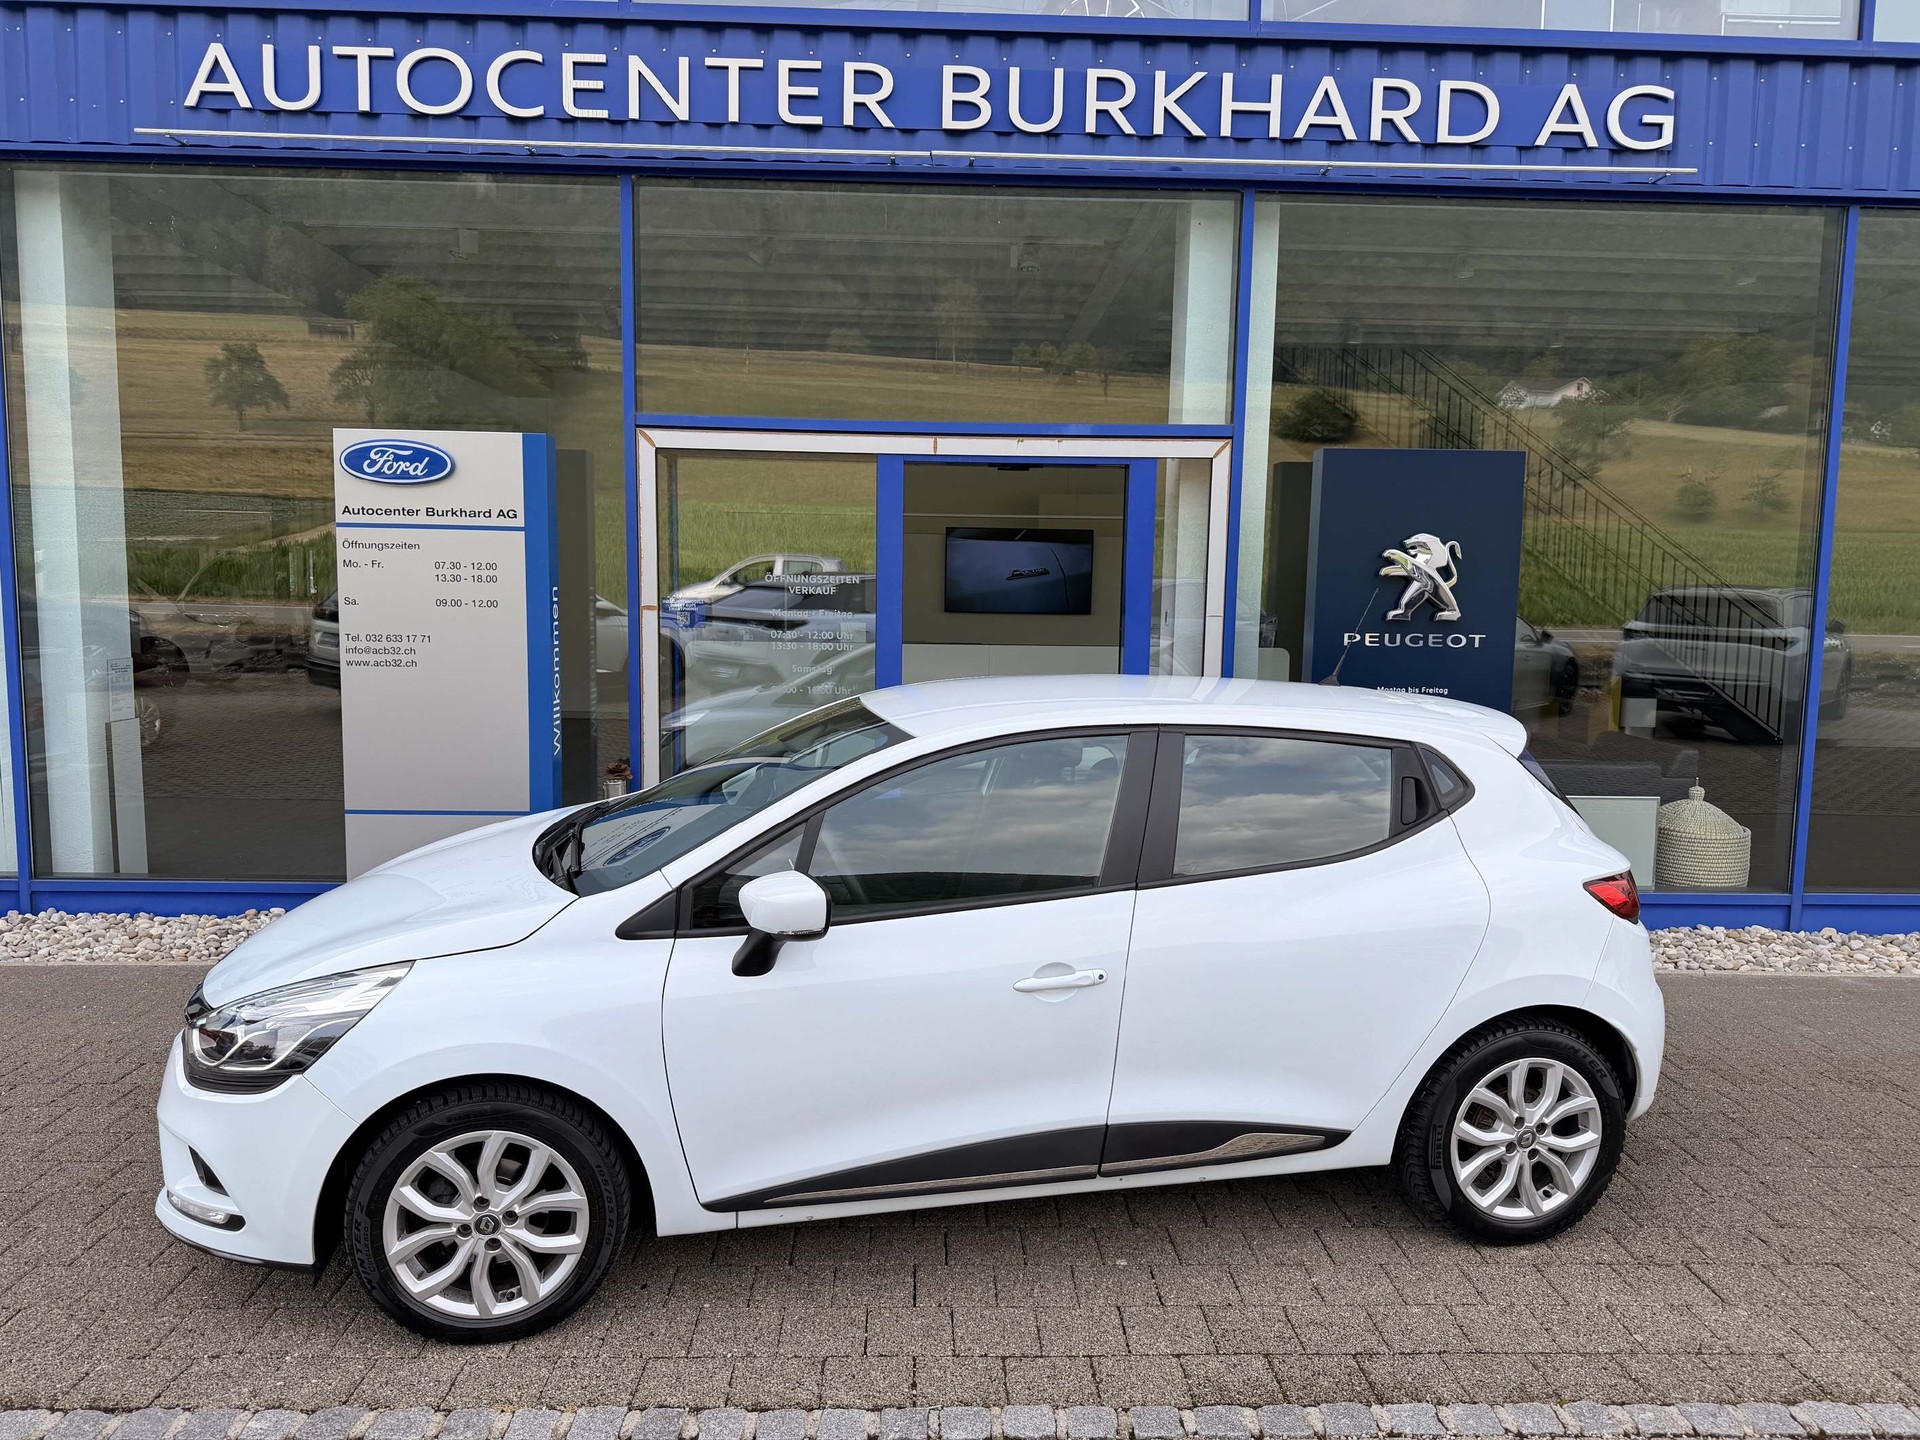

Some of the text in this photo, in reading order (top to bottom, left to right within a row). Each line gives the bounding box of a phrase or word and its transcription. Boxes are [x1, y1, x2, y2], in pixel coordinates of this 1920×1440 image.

[184, 41, 1676, 152] AUTOCENTER BURKHARD AG
[362, 447, 430, 477] Ford
[341, 505, 518, 520] Autocenter Burkhard AG
[342, 537, 420, 551] Öffnungszeiten
[342, 559, 362, 569] Mo.
[371, 559, 384, 569] Fr.
[434, 561, 462, 571] 07.30
[470, 561, 498, 571] 12.00
[435, 574, 462, 583] 13.30
[471, 574, 498, 583] 18.00
[764, 572, 860, 584] ÖFFNUNGSZEITEN
[788, 586, 837, 595] VERKAUF
[343, 597, 360, 606] Sa.
[435, 599, 463, 608] 09.00
[471, 599, 499, 609] 12.00
[772, 608, 809, 619] Montag
[344, 633, 432, 644] Tel. 032 633 17 71
[807, 631, 834, 640] 12:00
[836, 631, 854, 640] Uhr
[1343, 632, 1487, 648] PEUGEOT
[345, 646, 416, 656] info@acb32.ch
[771, 641, 798, 650] 13:30
[807, 642, 834, 651] 18:00
[836, 642, 854, 651] Uhr
[345, 658, 418, 668] www.acb32.ch
[552, 586, 562, 756] Willkommen
[834, 686, 852, 695] Uhr
[1421, 686, 1449, 695] Freitag
[1430, 1124, 1444, 1170] PIRELLI
[595, 1163, 614, 1215] 195/55
[353, 1200, 377, 1292] WINTER 2
